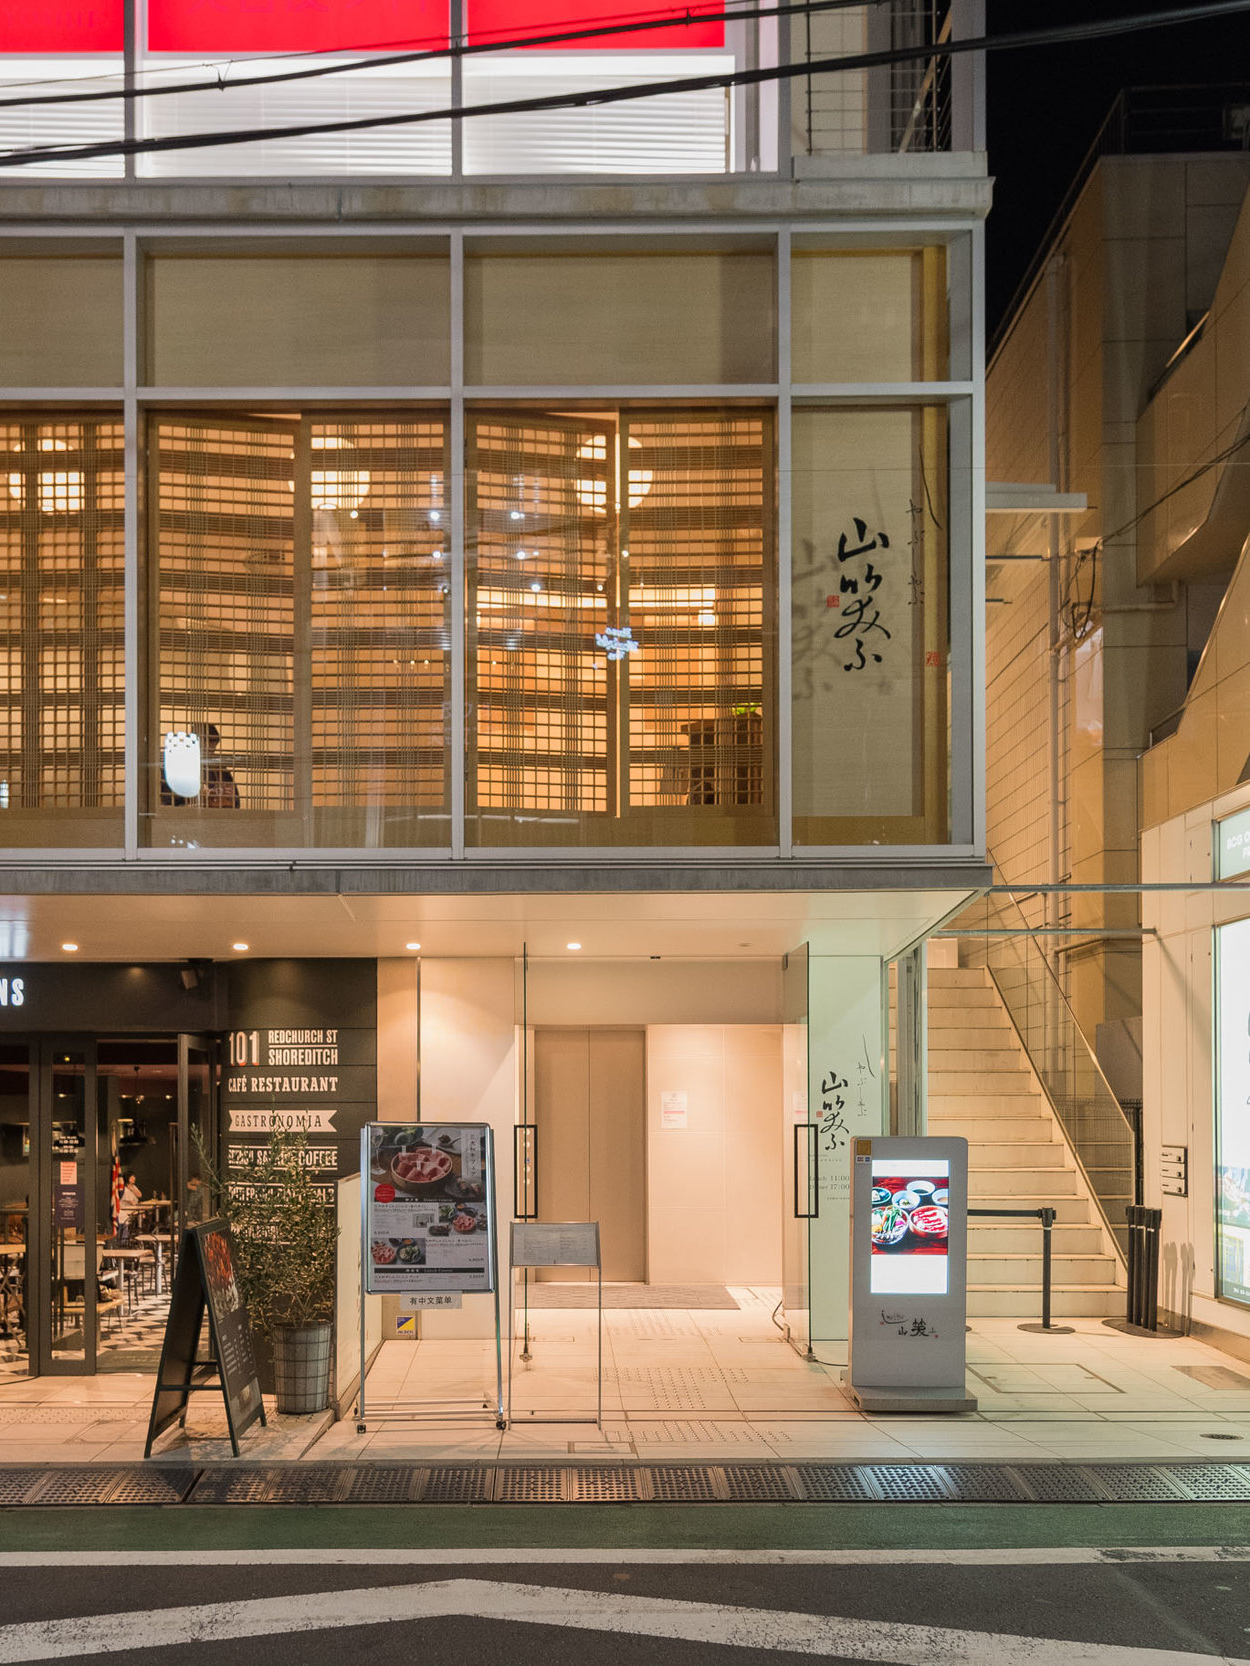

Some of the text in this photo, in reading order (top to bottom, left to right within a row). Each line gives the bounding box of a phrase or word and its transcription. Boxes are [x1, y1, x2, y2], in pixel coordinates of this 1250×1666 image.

[268, 1029, 338, 1044] REDCHURCH ST
[229, 1031, 260, 1067] 101
[268, 1048, 338, 1066] SHOREDITCH
[228, 1075, 338, 1093] CAFÉ RESTAURANT
[234, 1114, 322, 1129] GASTRONOMIA
[299, 1150, 338, 1166] COFFEE
